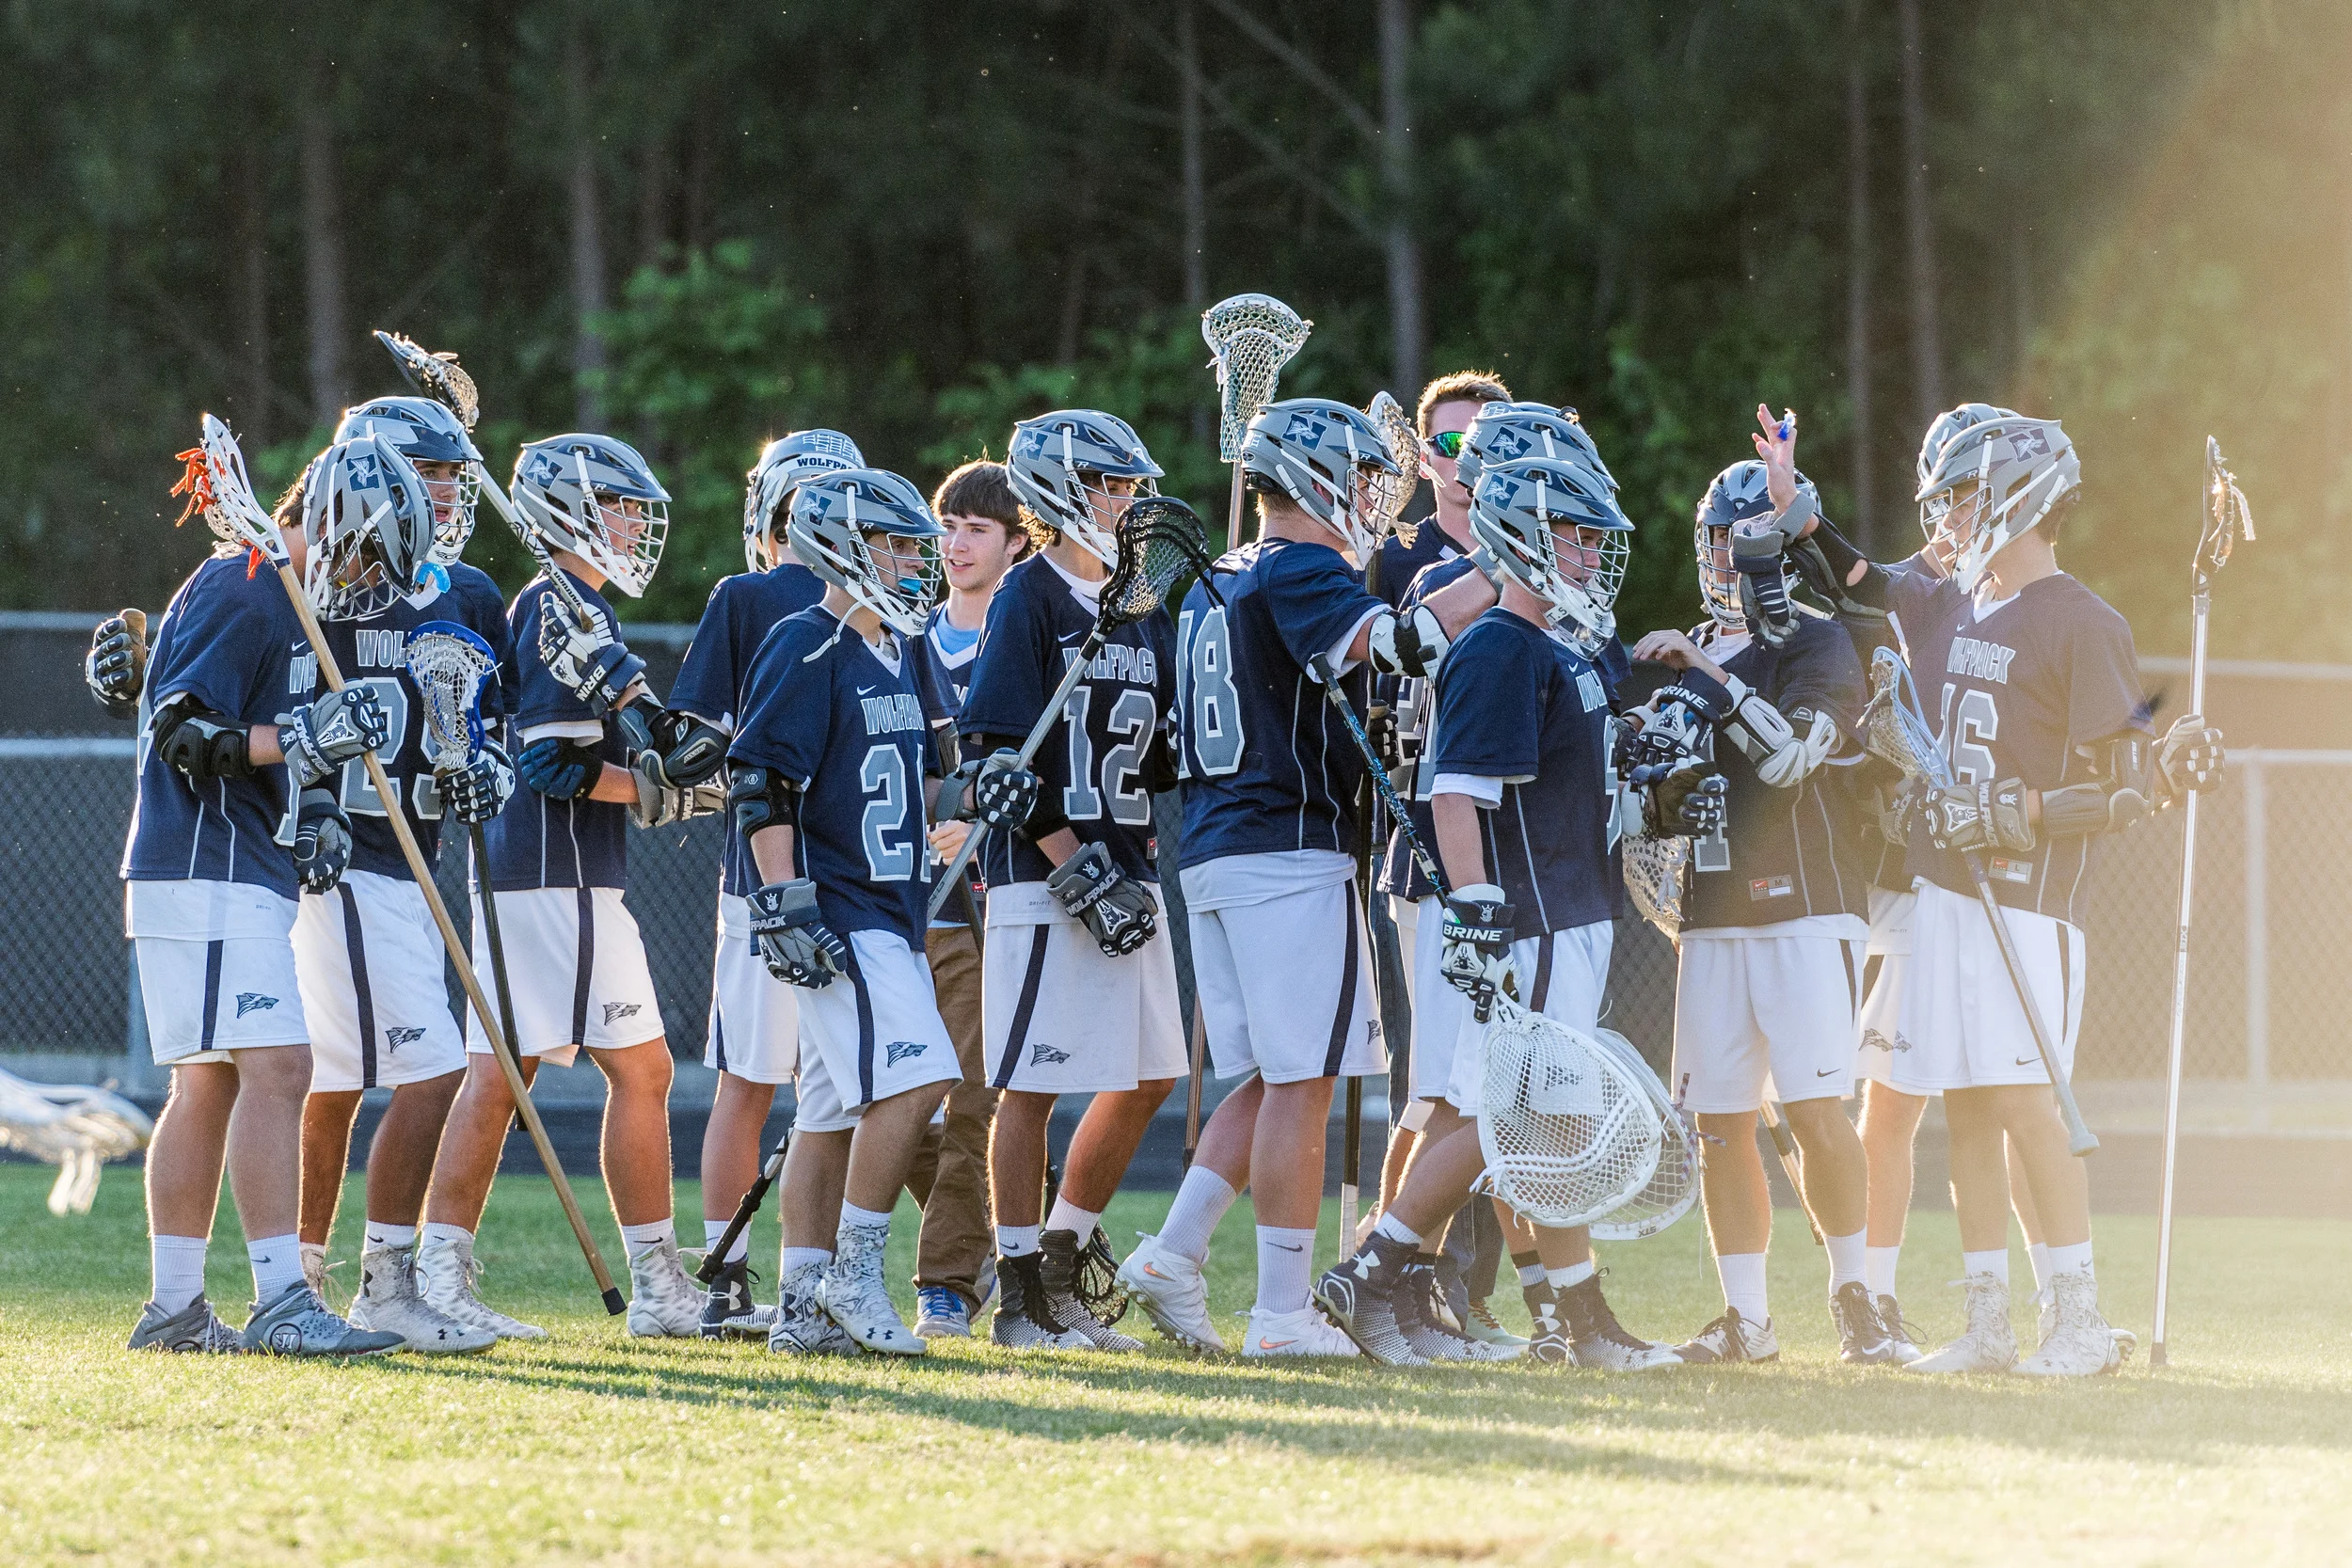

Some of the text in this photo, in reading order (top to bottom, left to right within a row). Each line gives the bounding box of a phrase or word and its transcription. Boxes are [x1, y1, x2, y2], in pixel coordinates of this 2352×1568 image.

[796, 457, 853, 470] WOLFPA
[356, 628, 414, 670] WOL
[1062, 643, 1158, 688] WLFPAC
[1062, 685, 1157, 826] 12
[1065, 867, 1121, 917] WOLFPACK
[1444, 923, 1503, 942] BRINE
